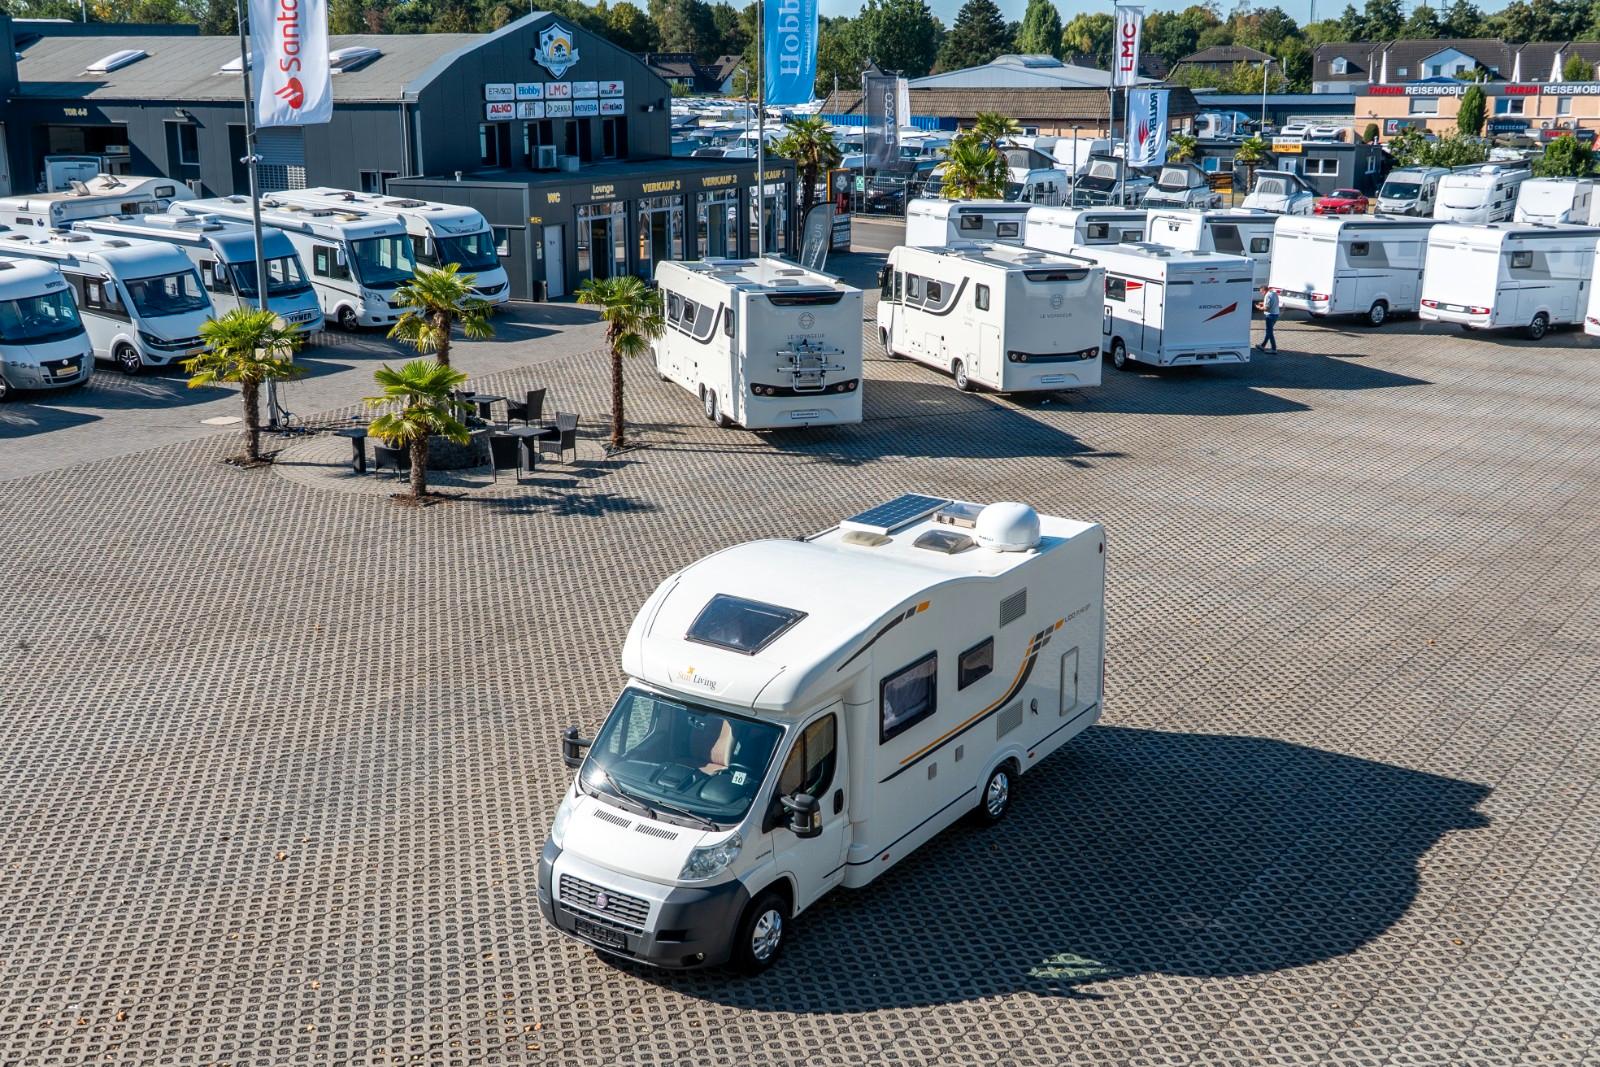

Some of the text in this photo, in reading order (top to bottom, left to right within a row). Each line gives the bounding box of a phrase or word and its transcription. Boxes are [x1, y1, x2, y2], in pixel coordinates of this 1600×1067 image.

[1120, 23, 1137, 72] LMC
[518, 85, 541, 97] Hobby
[548, 84, 569, 96] LMC
[554, 104, 571, 113] DEKRA
[702, 175, 738, 187] VERKAUF 2
[753, 170, 780, 181] VRKAUF
[592, 184, 614, 194] Lounge
[642, 180, 681, 193] VERKAUF 3
[547, 192, 560, 203] WC
[693, 674, 717, 690] Living
[735, 776, 743, 784] 10
